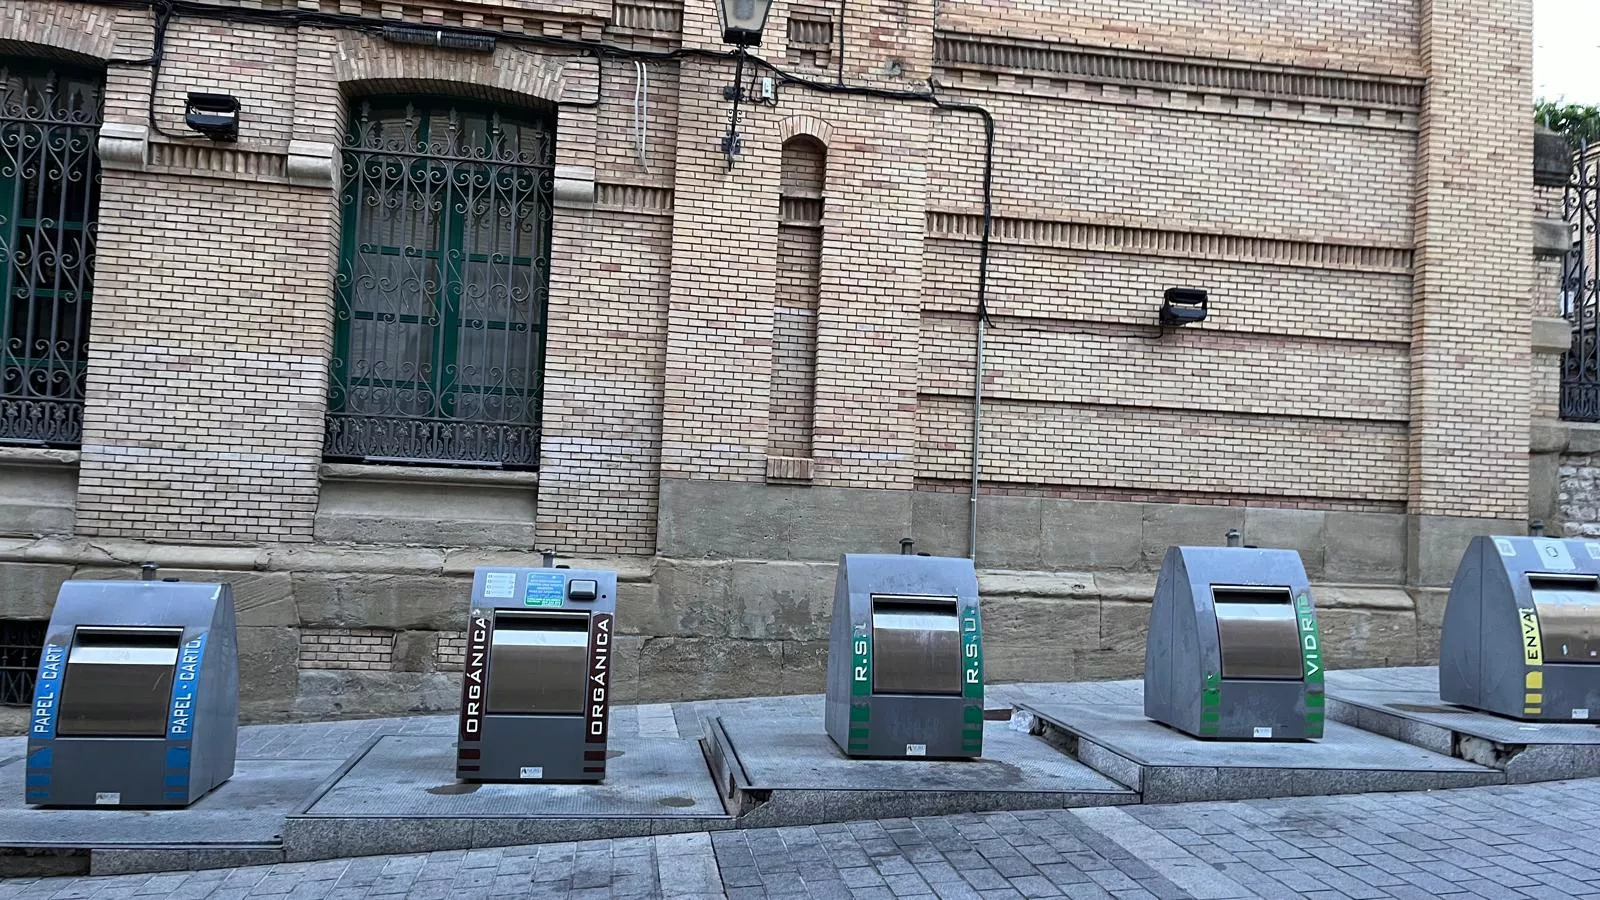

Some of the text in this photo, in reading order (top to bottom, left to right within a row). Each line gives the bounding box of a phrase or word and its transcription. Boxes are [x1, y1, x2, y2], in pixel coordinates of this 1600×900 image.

[34, 643, 64, 733] PAPEL CART
[172, 637, 203, 734] PAPEL CARTO
[466, 617, 488, 733] ORGÁNICA
[591, 618, 610, 735] ORGÁNICA
